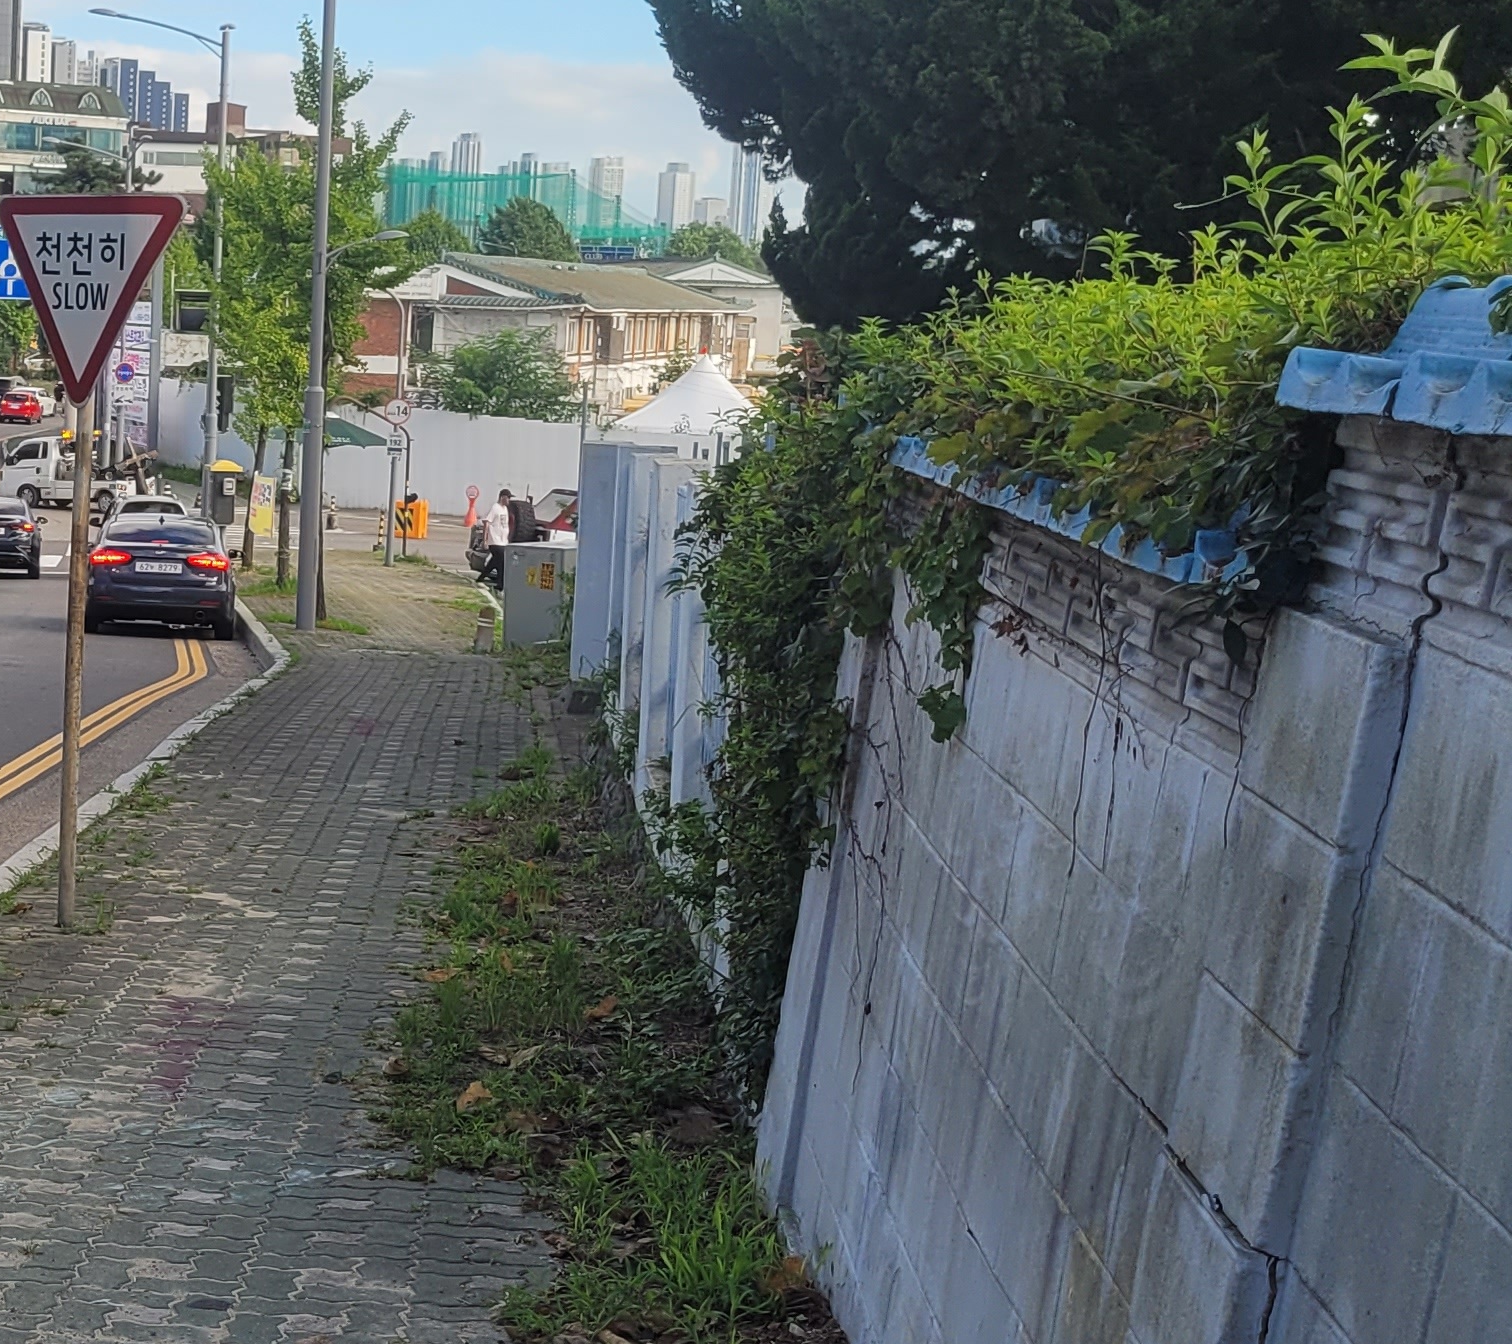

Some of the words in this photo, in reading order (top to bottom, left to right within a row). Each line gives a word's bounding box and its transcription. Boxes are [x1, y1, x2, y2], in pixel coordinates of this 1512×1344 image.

[35, 231, 126, 277] 천천히
[51, 281, 109, 311] SLOW
[396, 406, 409, 417] 14
[158, 564, 178, 572] 8279
